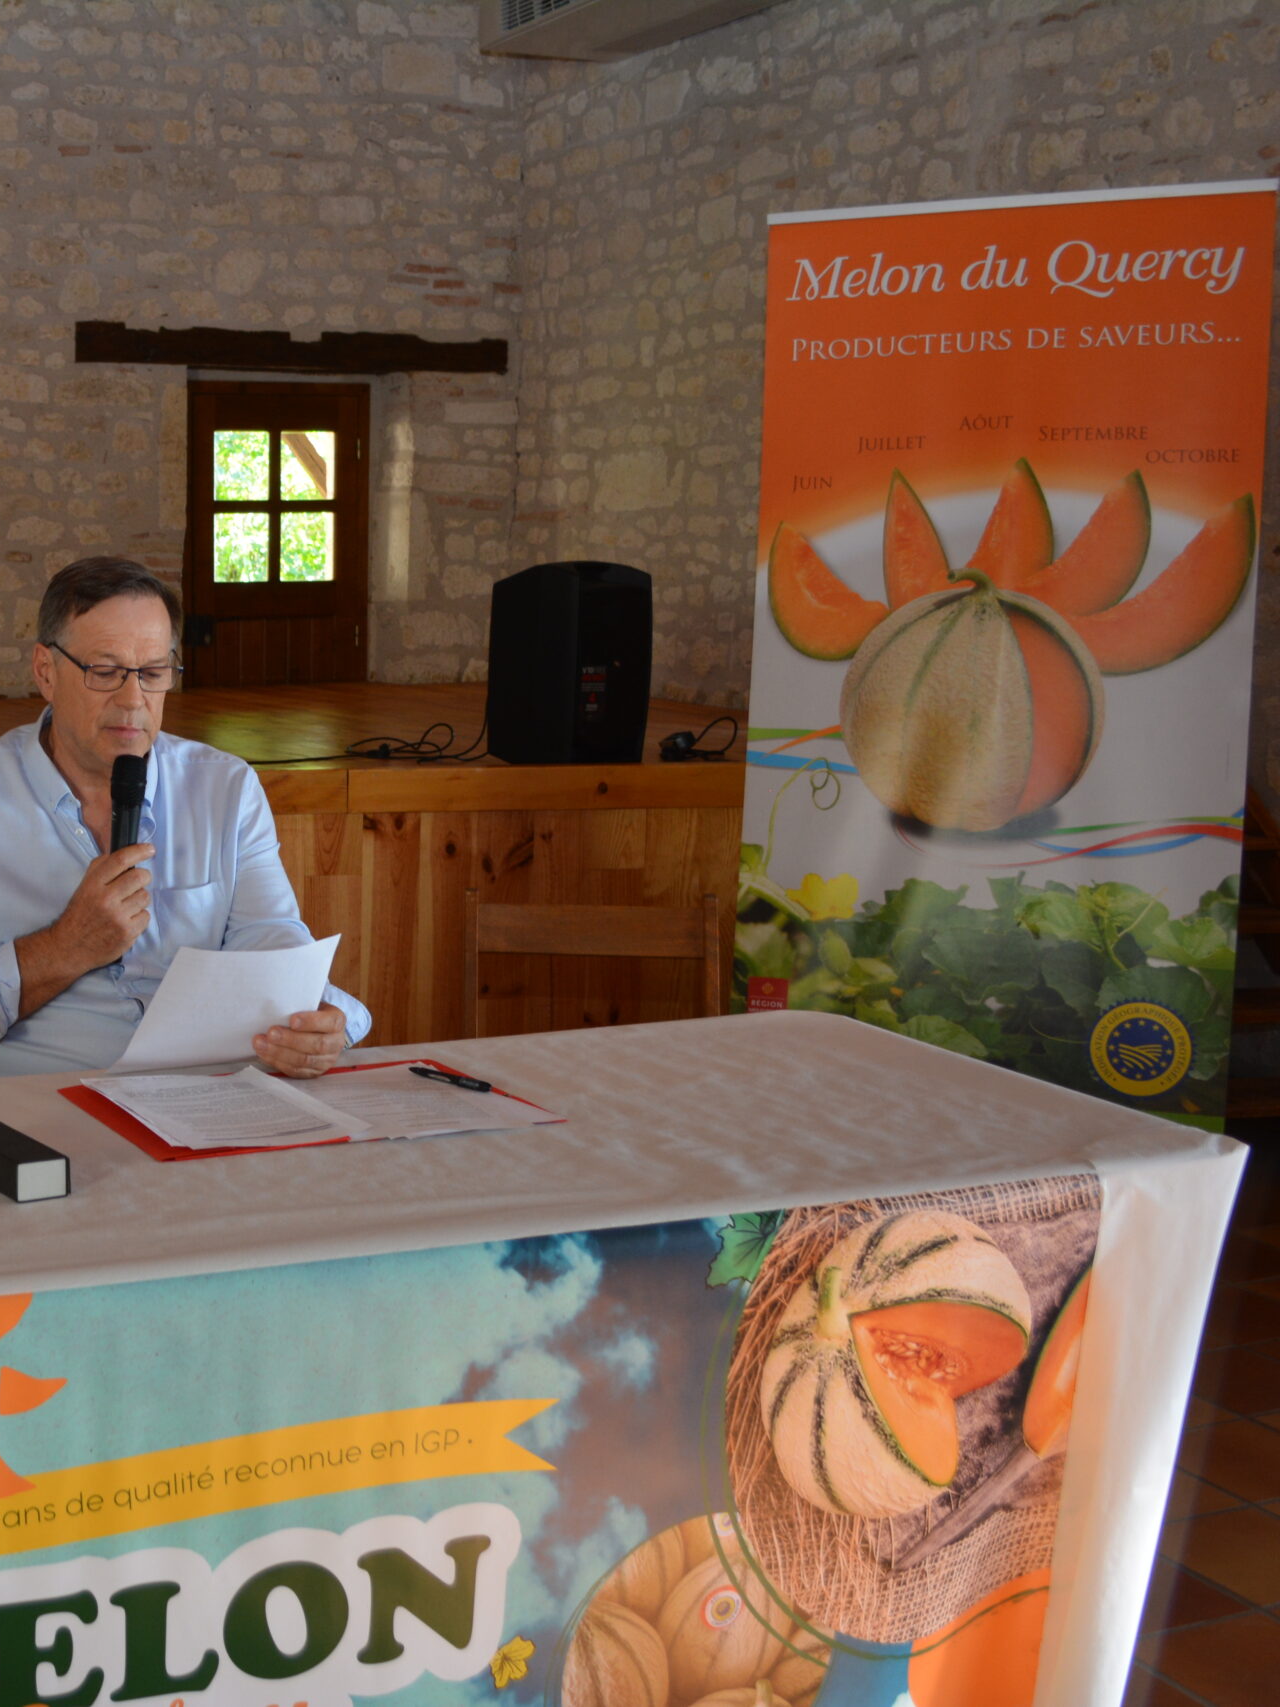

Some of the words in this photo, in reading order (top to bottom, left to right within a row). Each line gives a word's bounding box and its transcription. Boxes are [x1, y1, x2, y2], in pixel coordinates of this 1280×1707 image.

[786, 253, 945, 302] Melon
[960, 245, 1028, 290] du
[1047, 240, 1247, 299] Quercy
[792, 328, 1013, 362] PRODUCTEURS
[1027, 327, 1066, 350] DE
[1079, 321, 1243, 348] SAVEURS...
[1038, 425, 1149, 442] SEPTEMBRE
[857, 436, 927, 454] JUILLET
[1146, 449, 1242, 466] OCTOBRE
[792, 474, 833, 493] JUIN
[2, 1504, 60, 1532] ans
[65, 1490, 105, 1520] de
[112, 1464, 215, 1516] qualité
[222, 1440, 363, 1486] reconnue
[370, 1440, 408, 1462] en
[413, 1428, 461, 1456] IGP
